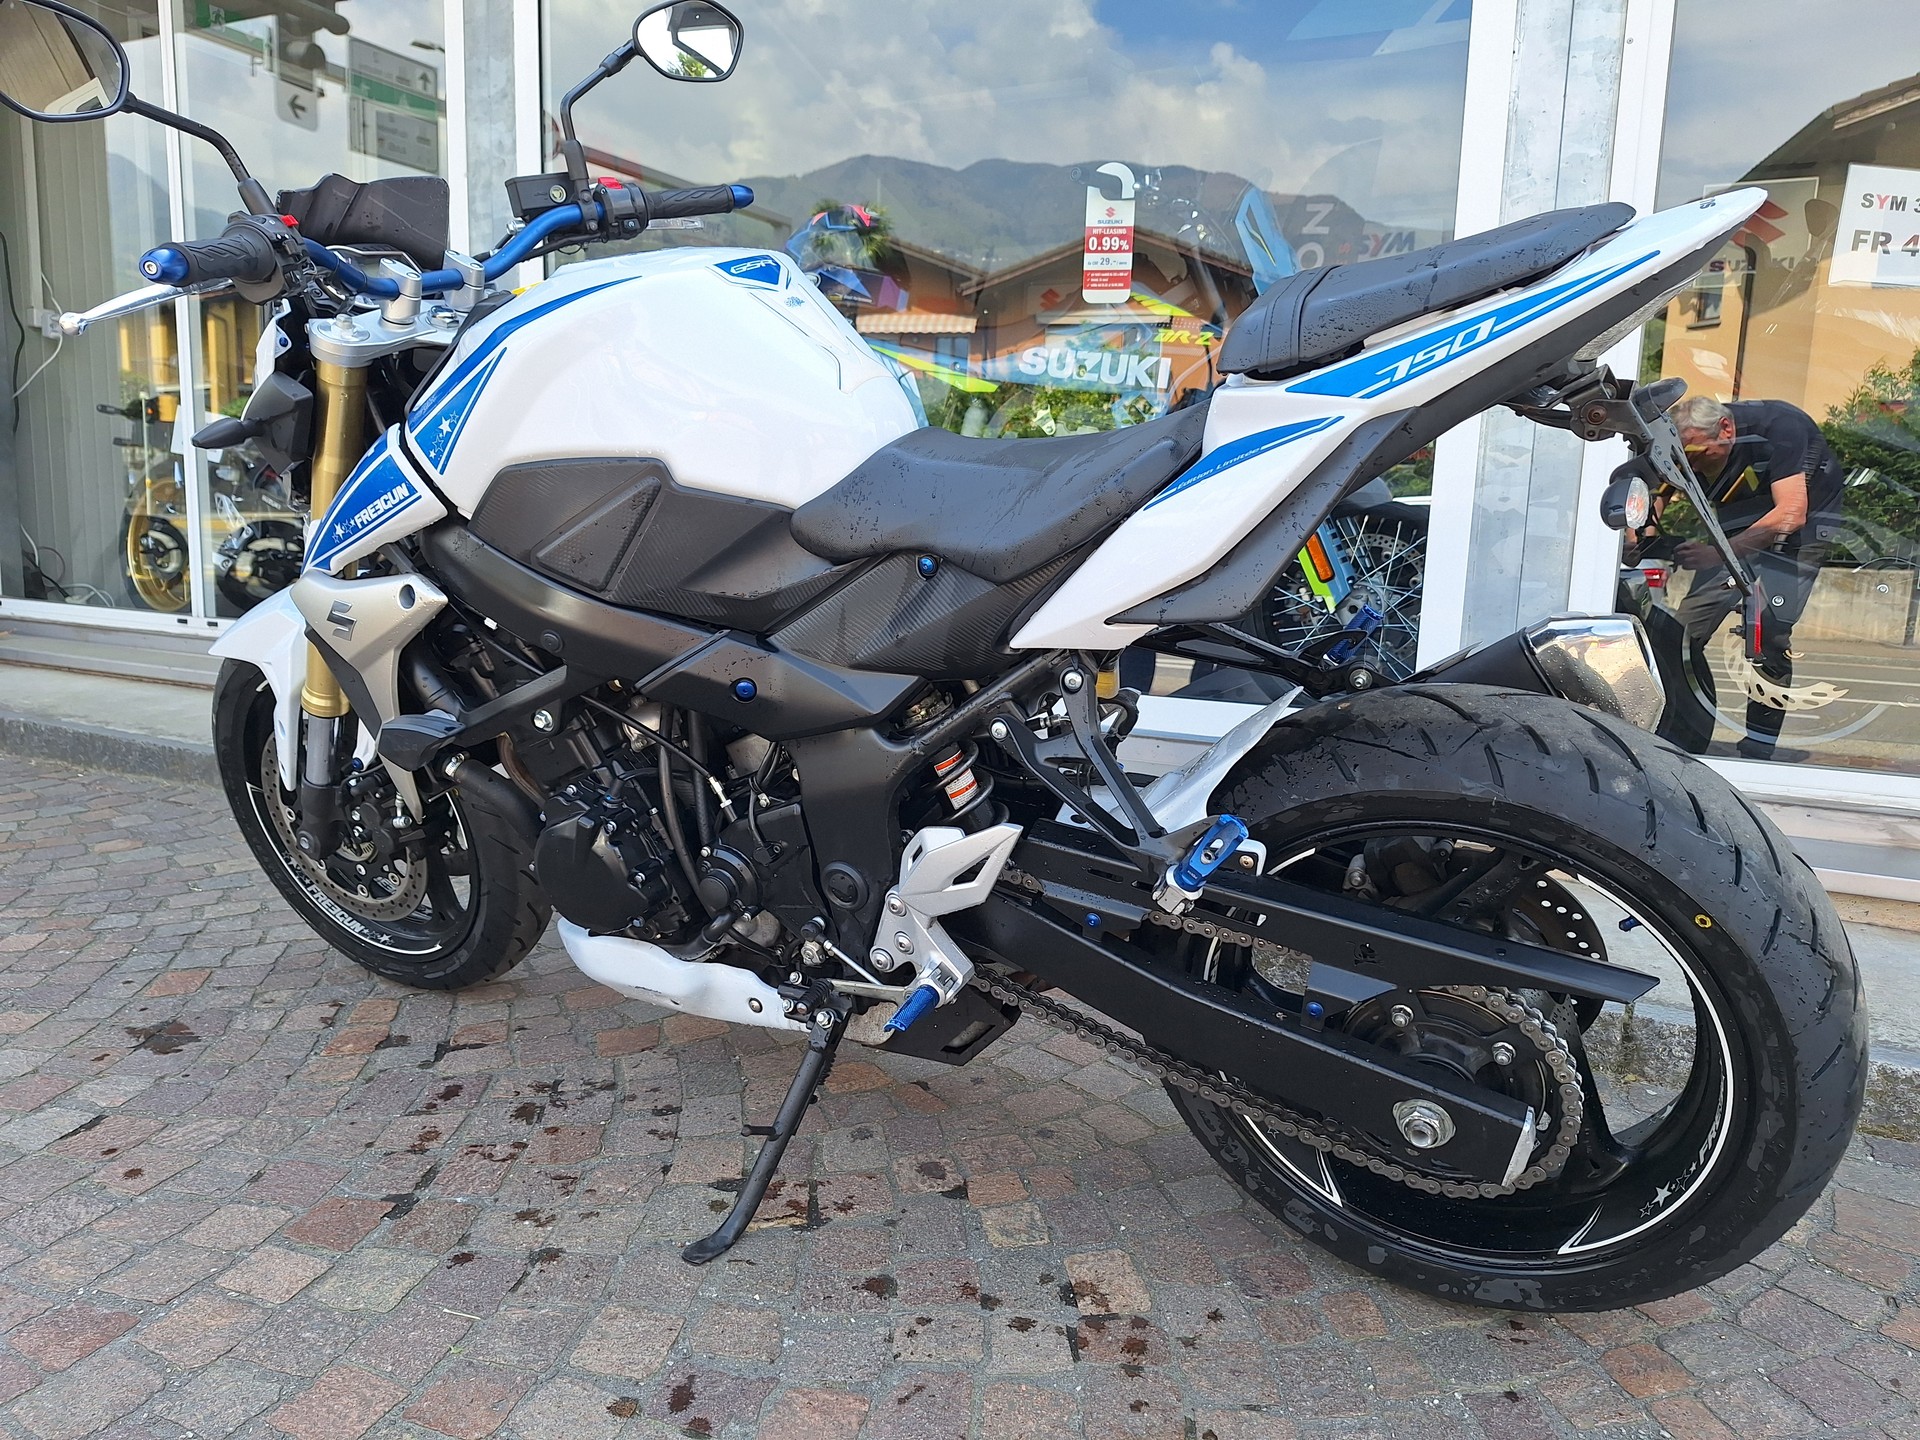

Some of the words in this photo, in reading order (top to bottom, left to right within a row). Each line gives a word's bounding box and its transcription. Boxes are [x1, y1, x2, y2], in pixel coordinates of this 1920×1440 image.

[1860, 192, 1908, 212] SYM
[1088, 236, 1130, 251] 0.99%
[1357, 231, 1415, 258] SYM
[1851, 229, 1892, 255] FR
[730, 259, 777, 275] GSR
[1153, 329, 1214, 346] DR-Z
[1375, 316, 1497, 383] 750
[1019, 346, 1172, 389] SUZUKI
[355, 482, 411, 529] FREEGUN
[307, 883, 366, 933] FREEGUN
